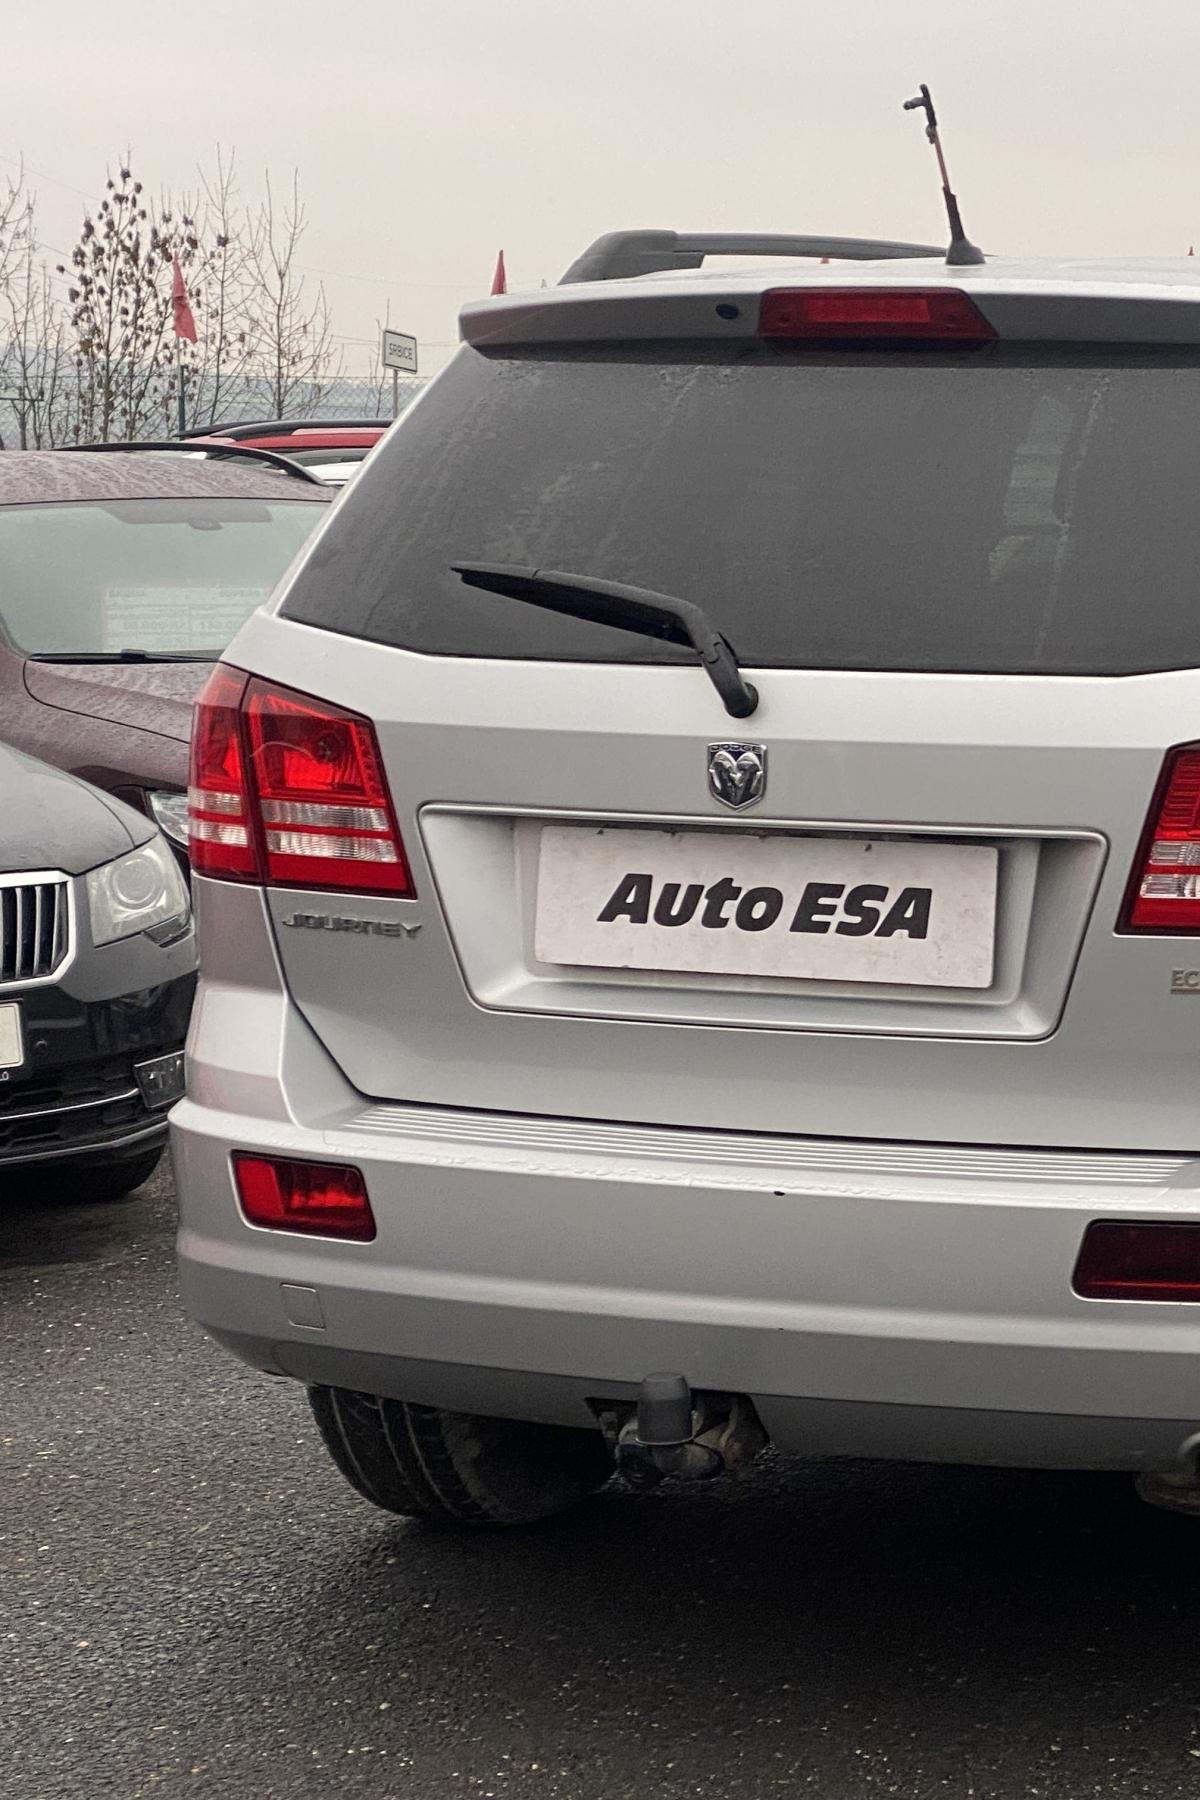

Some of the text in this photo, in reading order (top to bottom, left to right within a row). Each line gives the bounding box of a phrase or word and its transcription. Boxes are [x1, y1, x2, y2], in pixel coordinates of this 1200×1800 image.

[711, 744, 761, 753] DODGE
[597, 873, 932, 939] Auto ESA
[282, 912, 423, 939] JOURNEY
